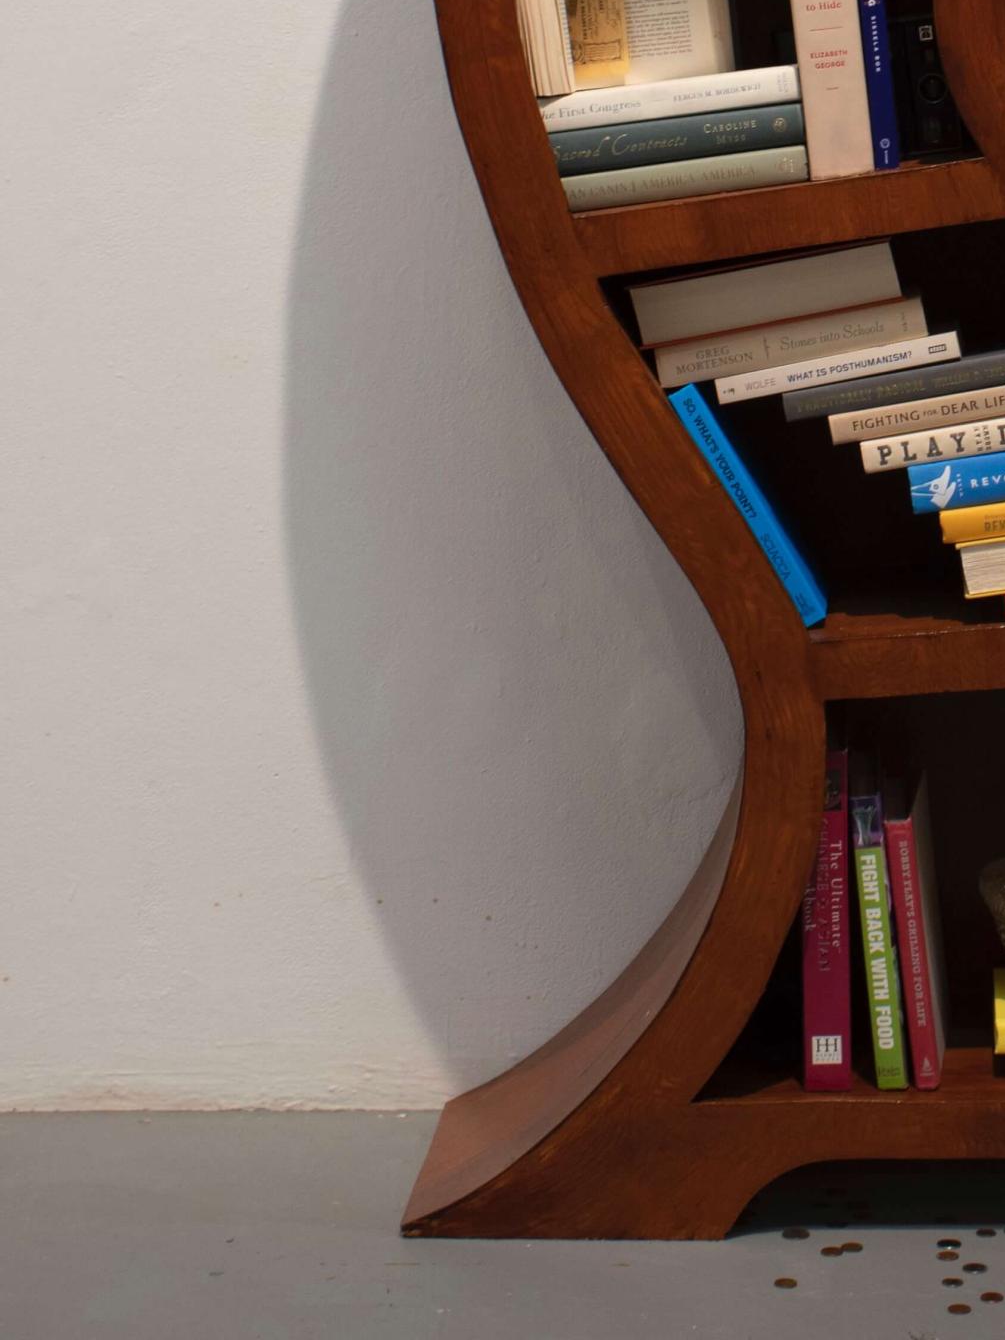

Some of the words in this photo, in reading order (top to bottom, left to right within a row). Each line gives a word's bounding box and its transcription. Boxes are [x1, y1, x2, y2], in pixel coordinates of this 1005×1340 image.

[806, 3, 816, 12] to
[819, 1, 842, 10] Hide
[810, 49, 848, 59] ELIZABETH
[815, 60, 845, 70] GEORGE
[558, 106, 586, 119] First
[589, 100, 642, 115] Congress
[779, 336, 817, 352] Stones
[819, 331, 840, 344] into
[843, 320, 885, 340] Schools
[676, 352, 753, 377] MORTENSON
[696, 345, 730, 360] GREG
[744, 377, 777, 392] WOLFE
[787, 368, 815, 384] WHAT
[816, 367, 827, 378] IS
[829, 351, 912, 376] POSTHUMANISM?
[852, 410, 920, 431] FIGHTING
[922, 409, 939, 418] FOR
[940, 400, 980, 417] DEAR
[877, 432, 967, 466] PLAY
[715, 453, 736, 483] YOUR
[731, 482, 757, 519] POINT?
[830, 840, 843, 870] The
[898, 841, 911, 877] BOBBY
[860, 854, 881, 901] FIGHT
[830, 878, 843, 947] Ultimate
[865, 907, 885, 953] BACK
[907, 922, 921, 974] GRILLING
[871, 957, 890, 1001] WITH
[913, 975, 924, 999] FOR
[875, 1005, 895, 1050] FOOD
[916, 1001, 926, 1027] LIFE
